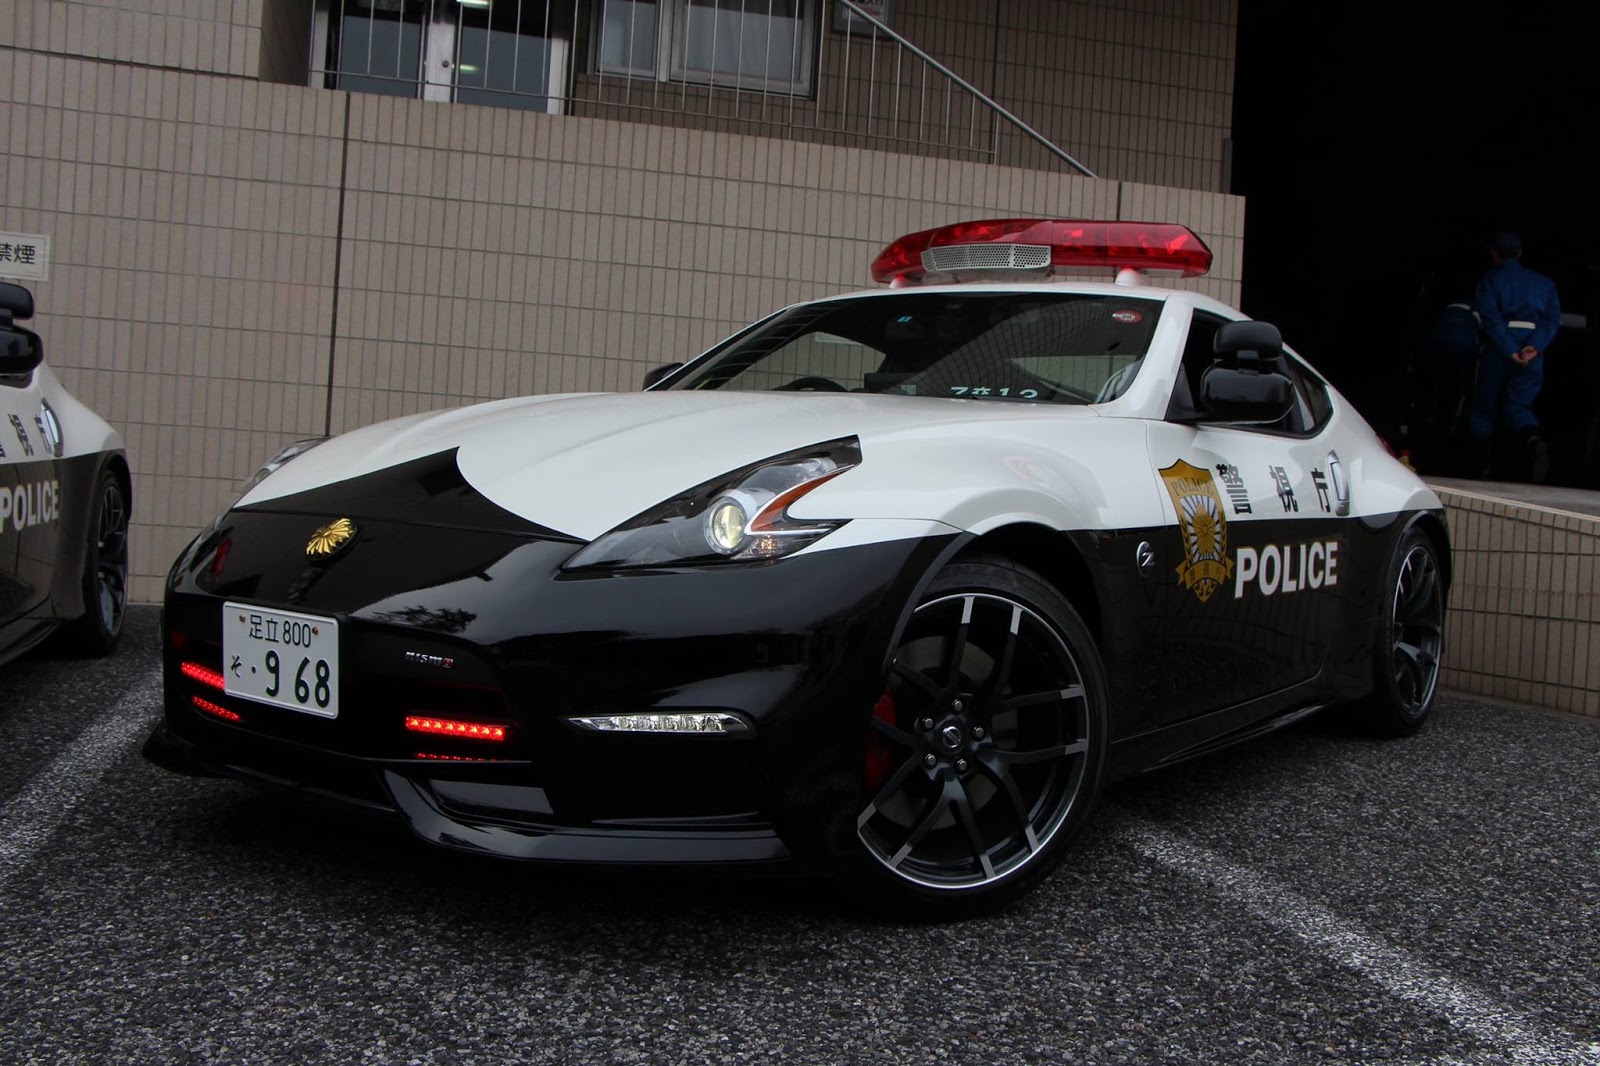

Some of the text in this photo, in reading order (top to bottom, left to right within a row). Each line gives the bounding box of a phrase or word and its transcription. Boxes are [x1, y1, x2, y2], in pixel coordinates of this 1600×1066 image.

[0, 243, 36, 264] 禁煙
[0, 412, 52, 457] 視庁
[0, 480, 59, 533] POLICE
[1215, 463, 1331, 514] 警視庁
[1233, 541, 1338, 599] POLICE
